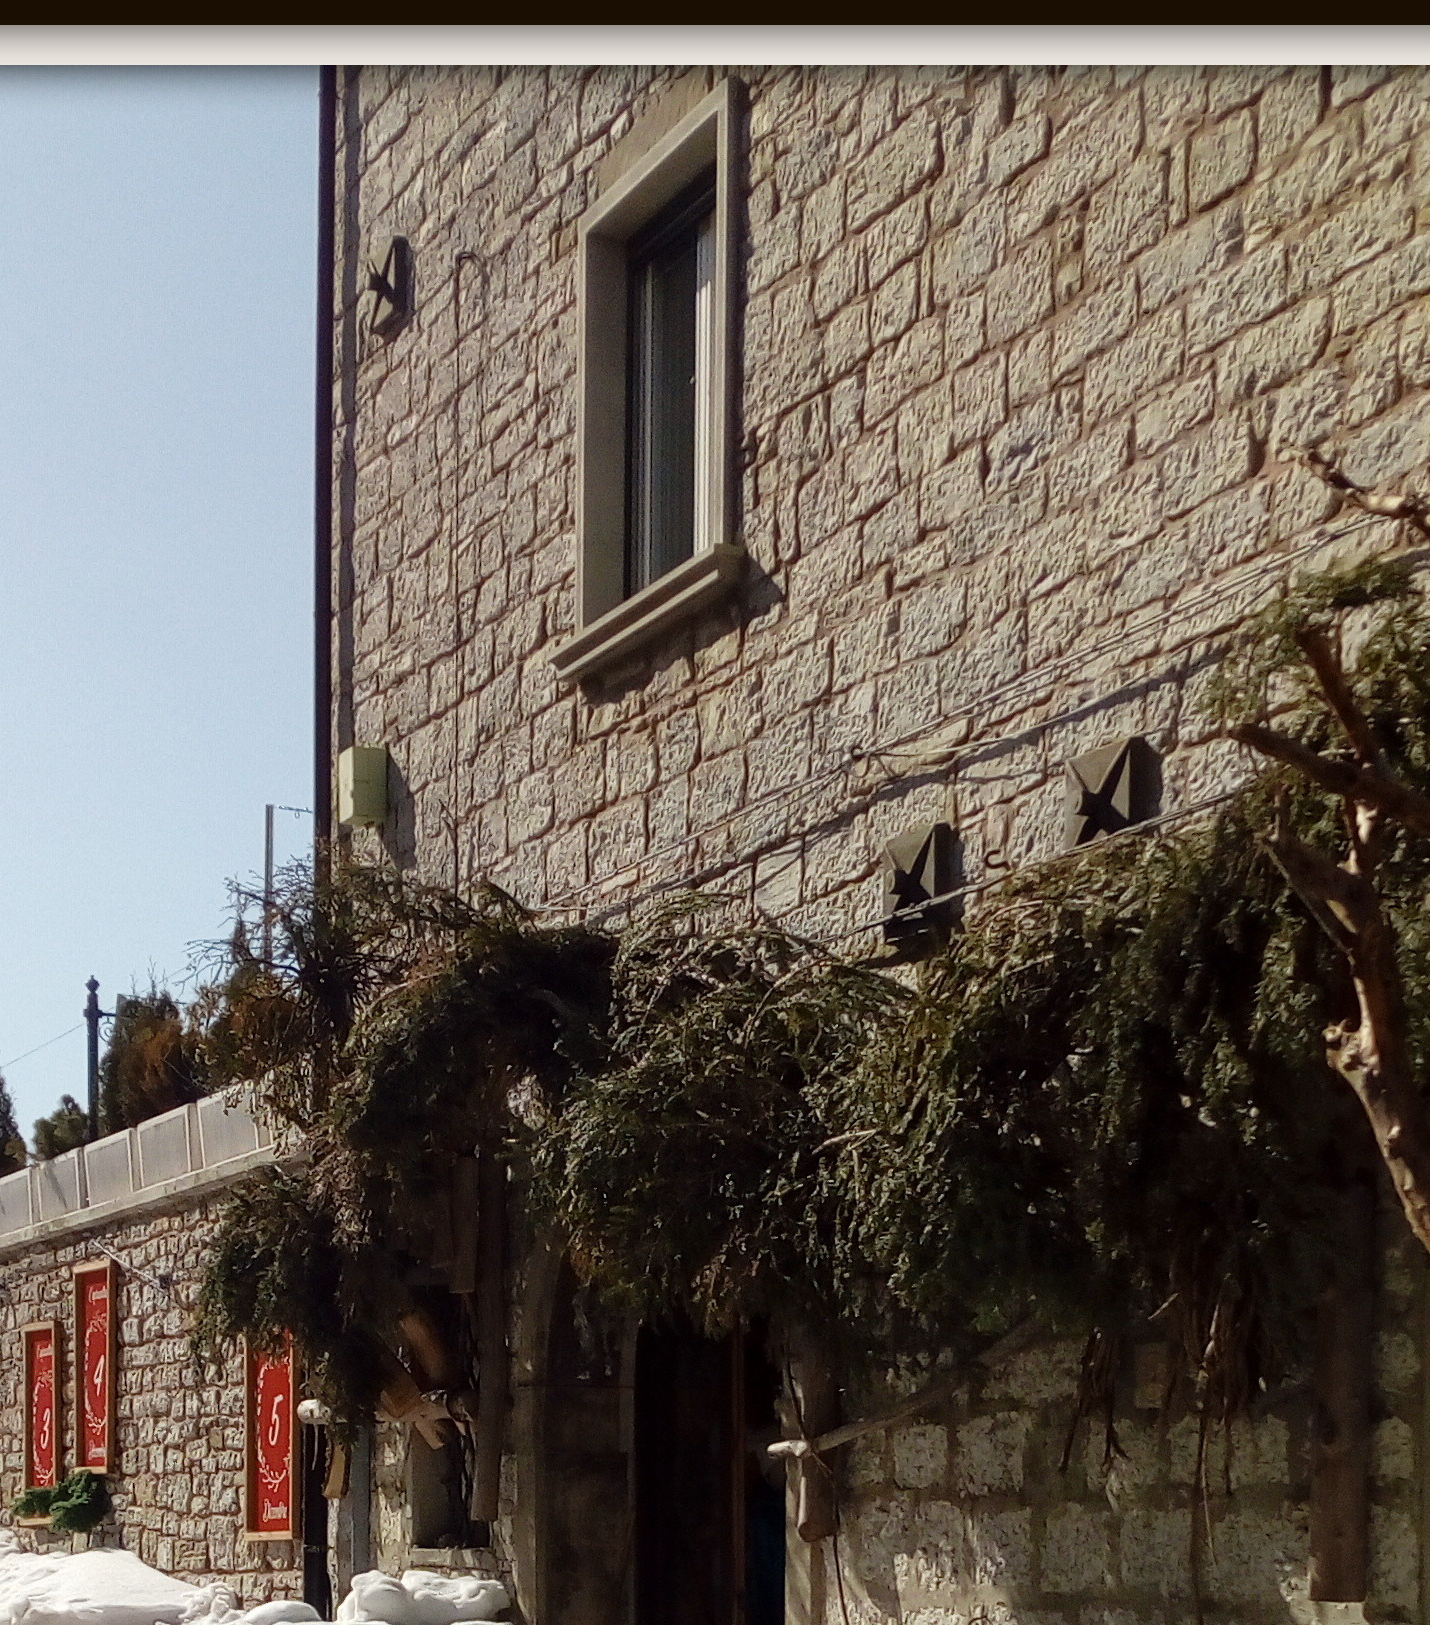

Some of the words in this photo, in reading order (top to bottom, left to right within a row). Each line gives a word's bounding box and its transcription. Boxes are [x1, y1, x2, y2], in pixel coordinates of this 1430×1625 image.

[93, 1354, 105, 1397] 4
[40, 1407, 51, 1450] 3
[268, 1394, 284, 1446] 5
